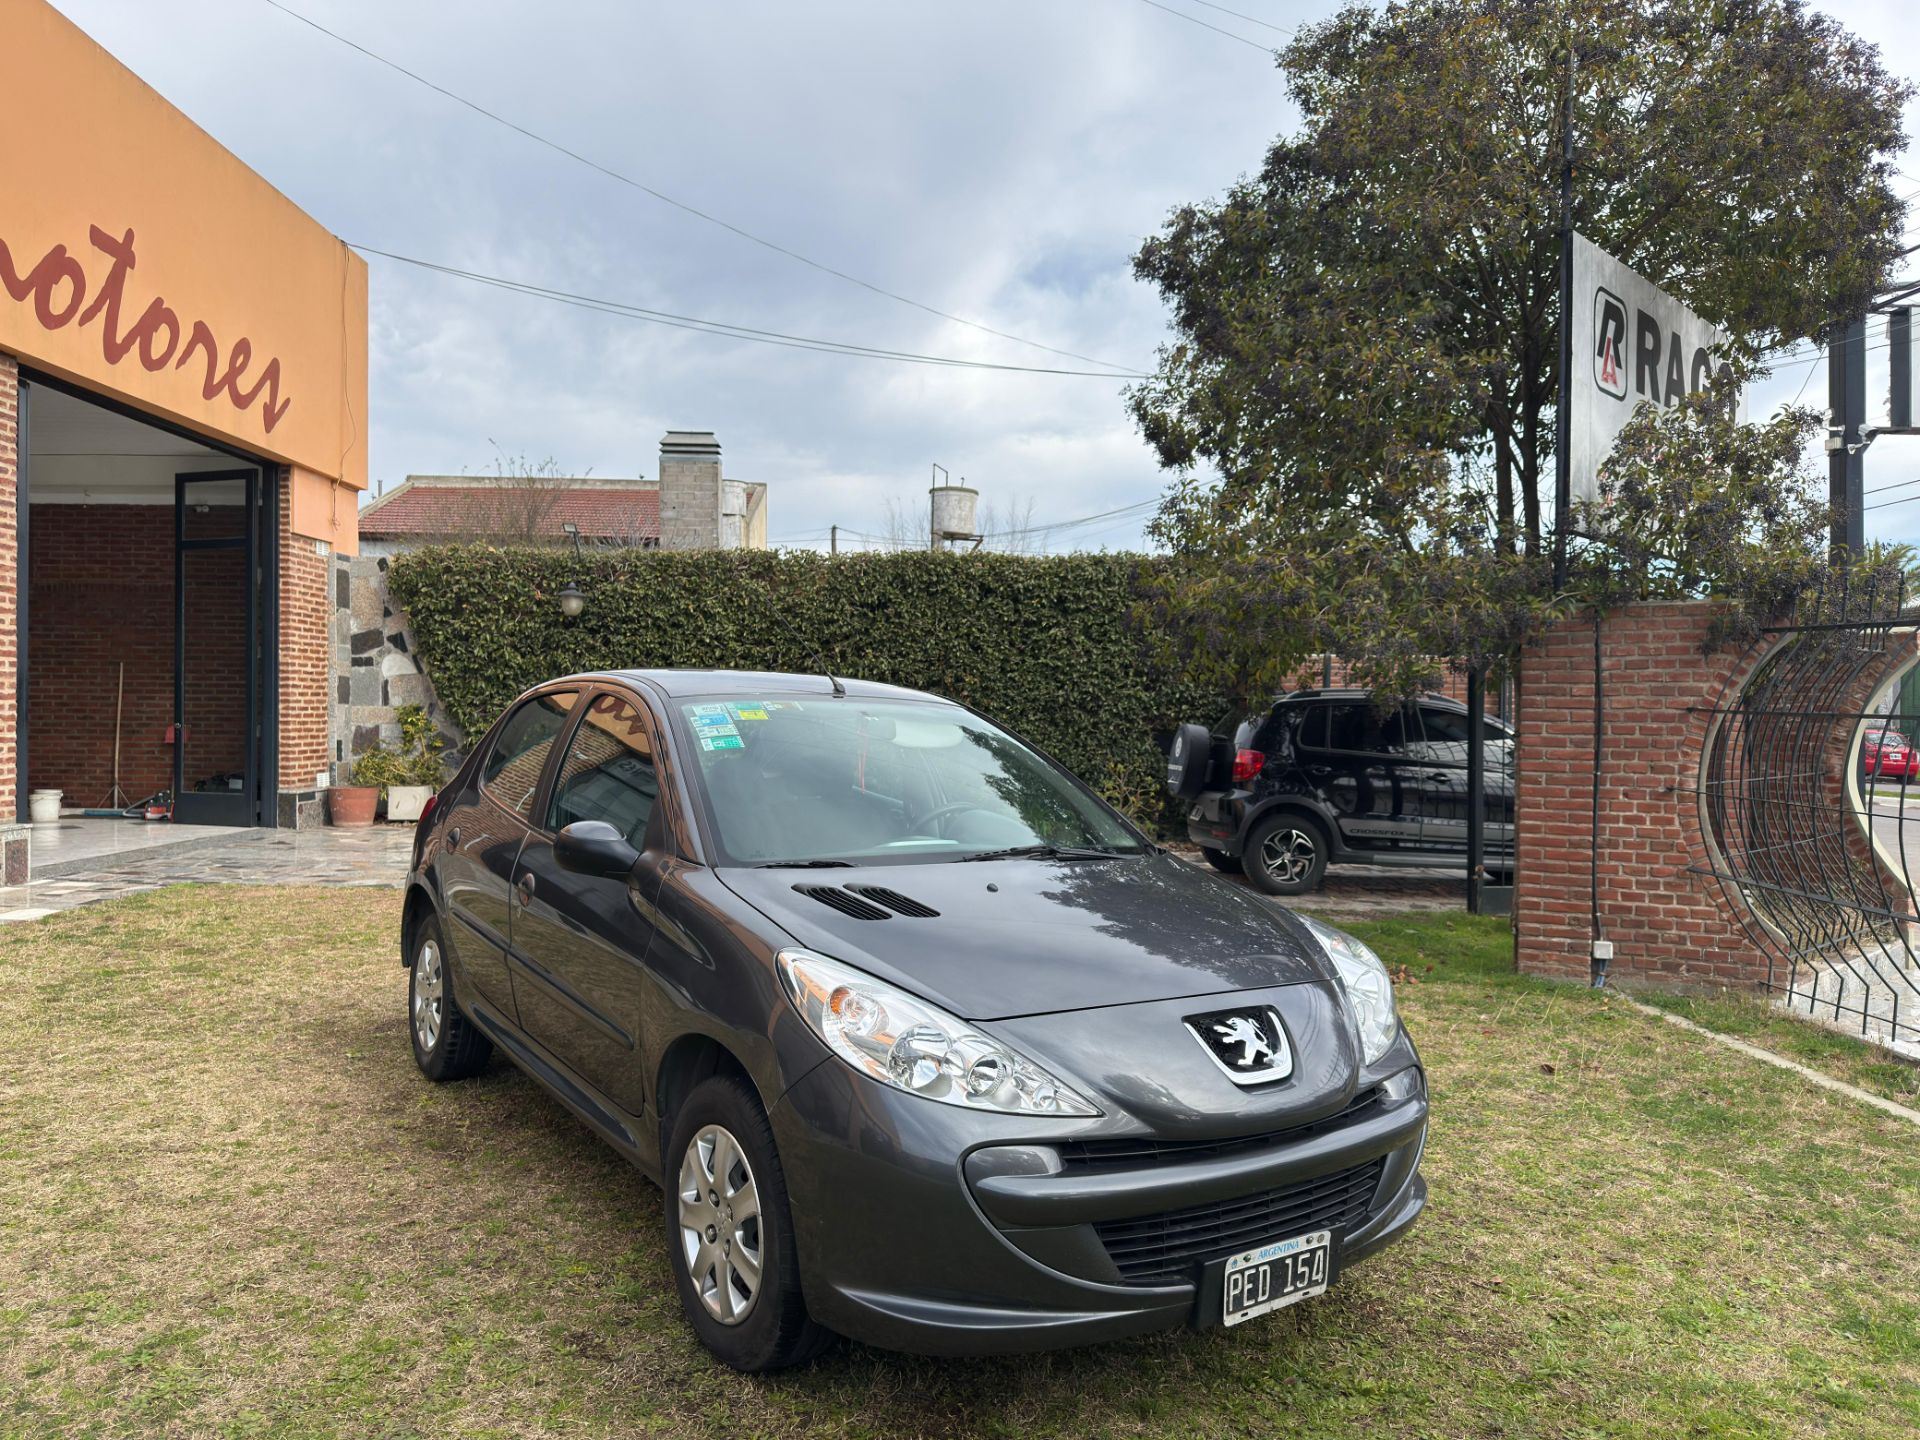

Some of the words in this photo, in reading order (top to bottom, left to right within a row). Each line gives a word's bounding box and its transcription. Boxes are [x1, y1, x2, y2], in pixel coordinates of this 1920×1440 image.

[1257, 1240, 1300, 1260] ARGENTINA
[1228, 1264, 1271, 1312] PED
[1283, 1249, 1324, 1293] 154
